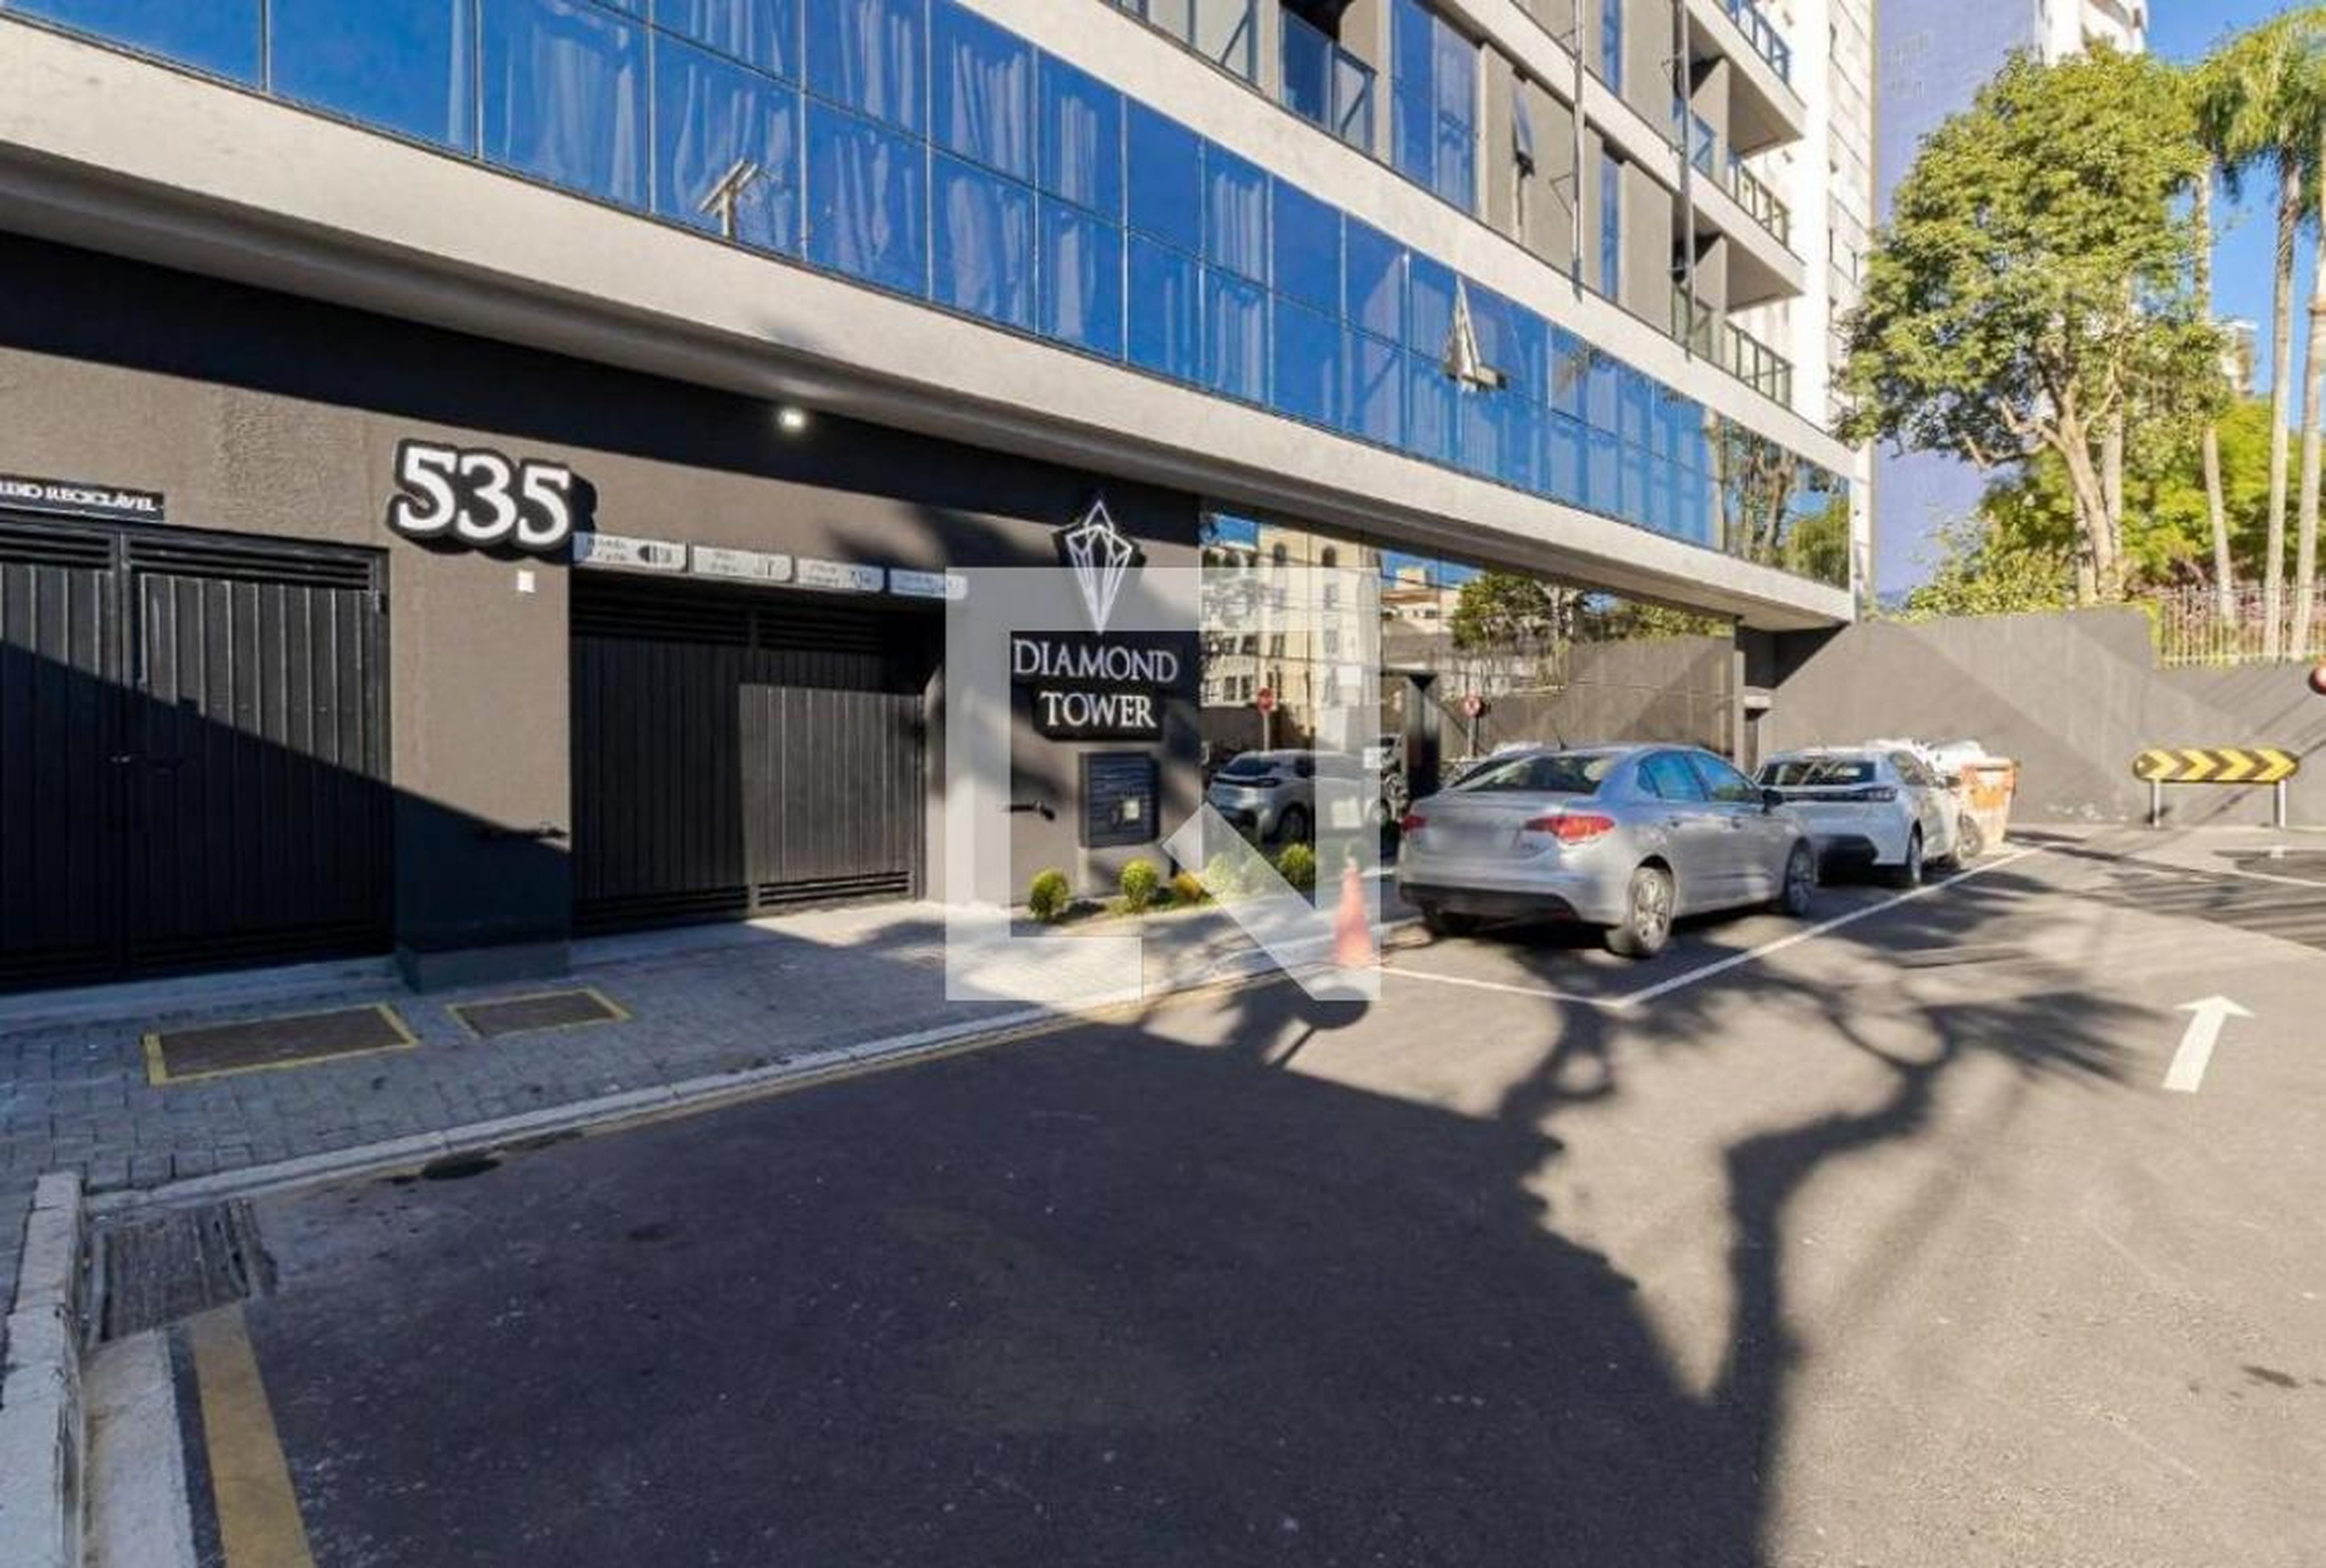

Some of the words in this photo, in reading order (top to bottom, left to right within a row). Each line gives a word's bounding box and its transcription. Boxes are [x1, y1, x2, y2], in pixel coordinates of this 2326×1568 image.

[398, 446, 571, 544] 535
[1013, 638, 1179, 683] DIAMOND
[1039, 690, 1157, 727] TOWER
